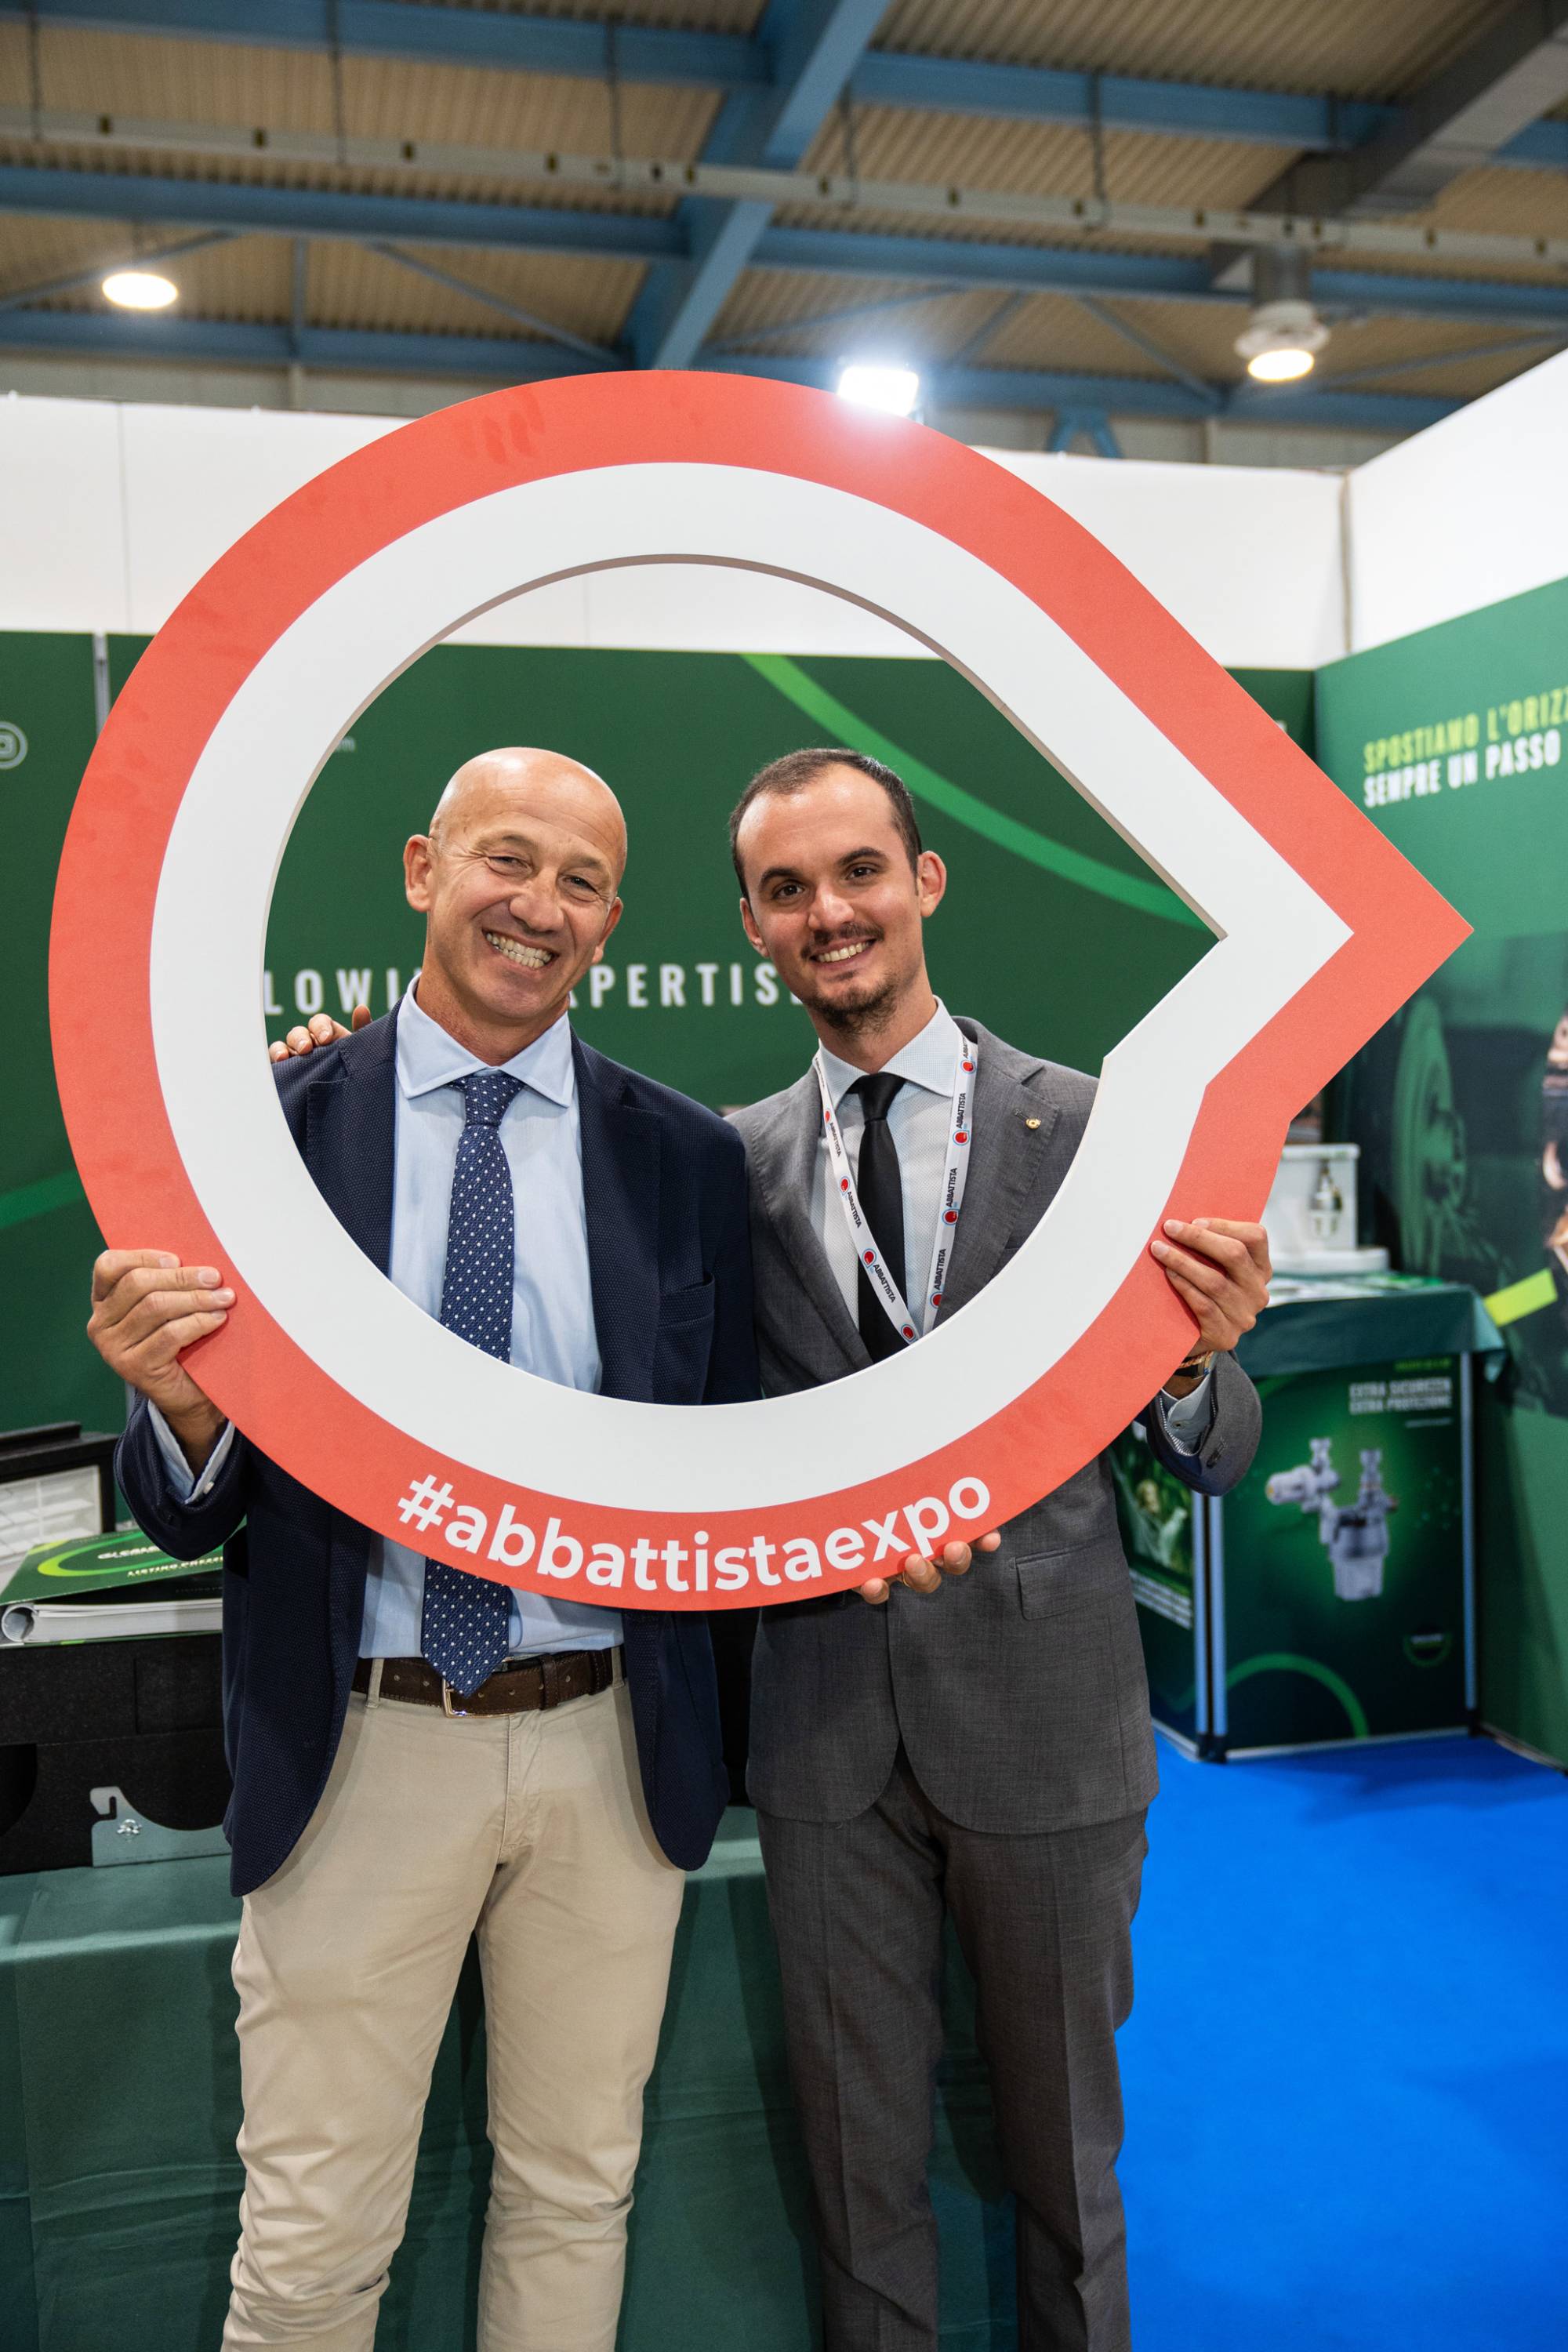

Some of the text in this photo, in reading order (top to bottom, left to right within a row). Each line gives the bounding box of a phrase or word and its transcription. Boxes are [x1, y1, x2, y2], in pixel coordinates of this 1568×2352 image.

[1364, 713, 1479, 774] SPOSTIAMO
[1364, 728, 1561, 808] SEMPRE UN PASSO
[956, 1093, 966, 1128] ABBATTISTA
[946, 1167, 957, 1207] ABBATTISTA
[848, 1191, 862, 1229] ABBATTISTA
[873, 1264, 896, 1303] ABBATTISTA
[934, 1248, 946, 1290] ABBATTISTA
[397, 1475, 990, 1592] #abbattistaexpo
